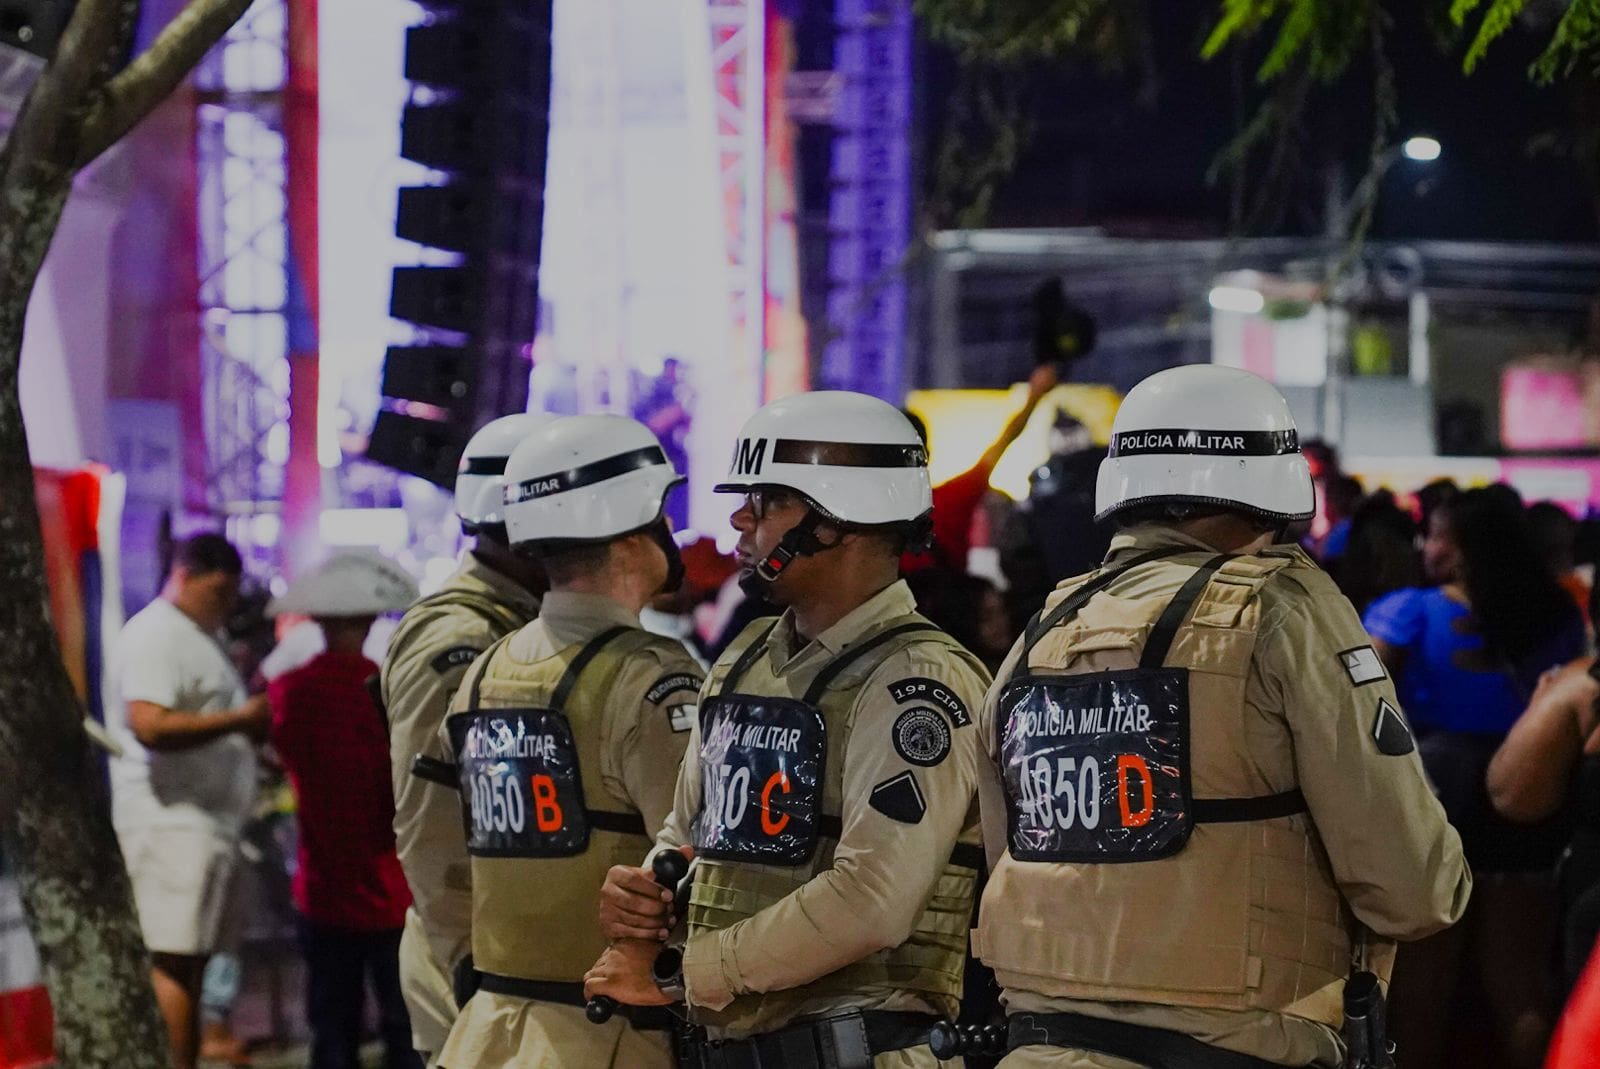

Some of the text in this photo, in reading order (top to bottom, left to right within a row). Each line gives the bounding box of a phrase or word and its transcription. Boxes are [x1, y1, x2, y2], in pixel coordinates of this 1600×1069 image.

[729, 438, 768, 475] M
[1120, 432, 1245, 450] POLÍCIA MILITAR
[509, 477, 560, 500] ILITAR
[932, 688, 967, 724] CIPM
[1078, 704, 1150, 734] MILITAR
[741, 724, 801, 753] MILITAR
[470, 774, 563, 834] 4050 B
[761, 770, 791, 836] C
[1019, 754, 1154, 831] 4050 D
